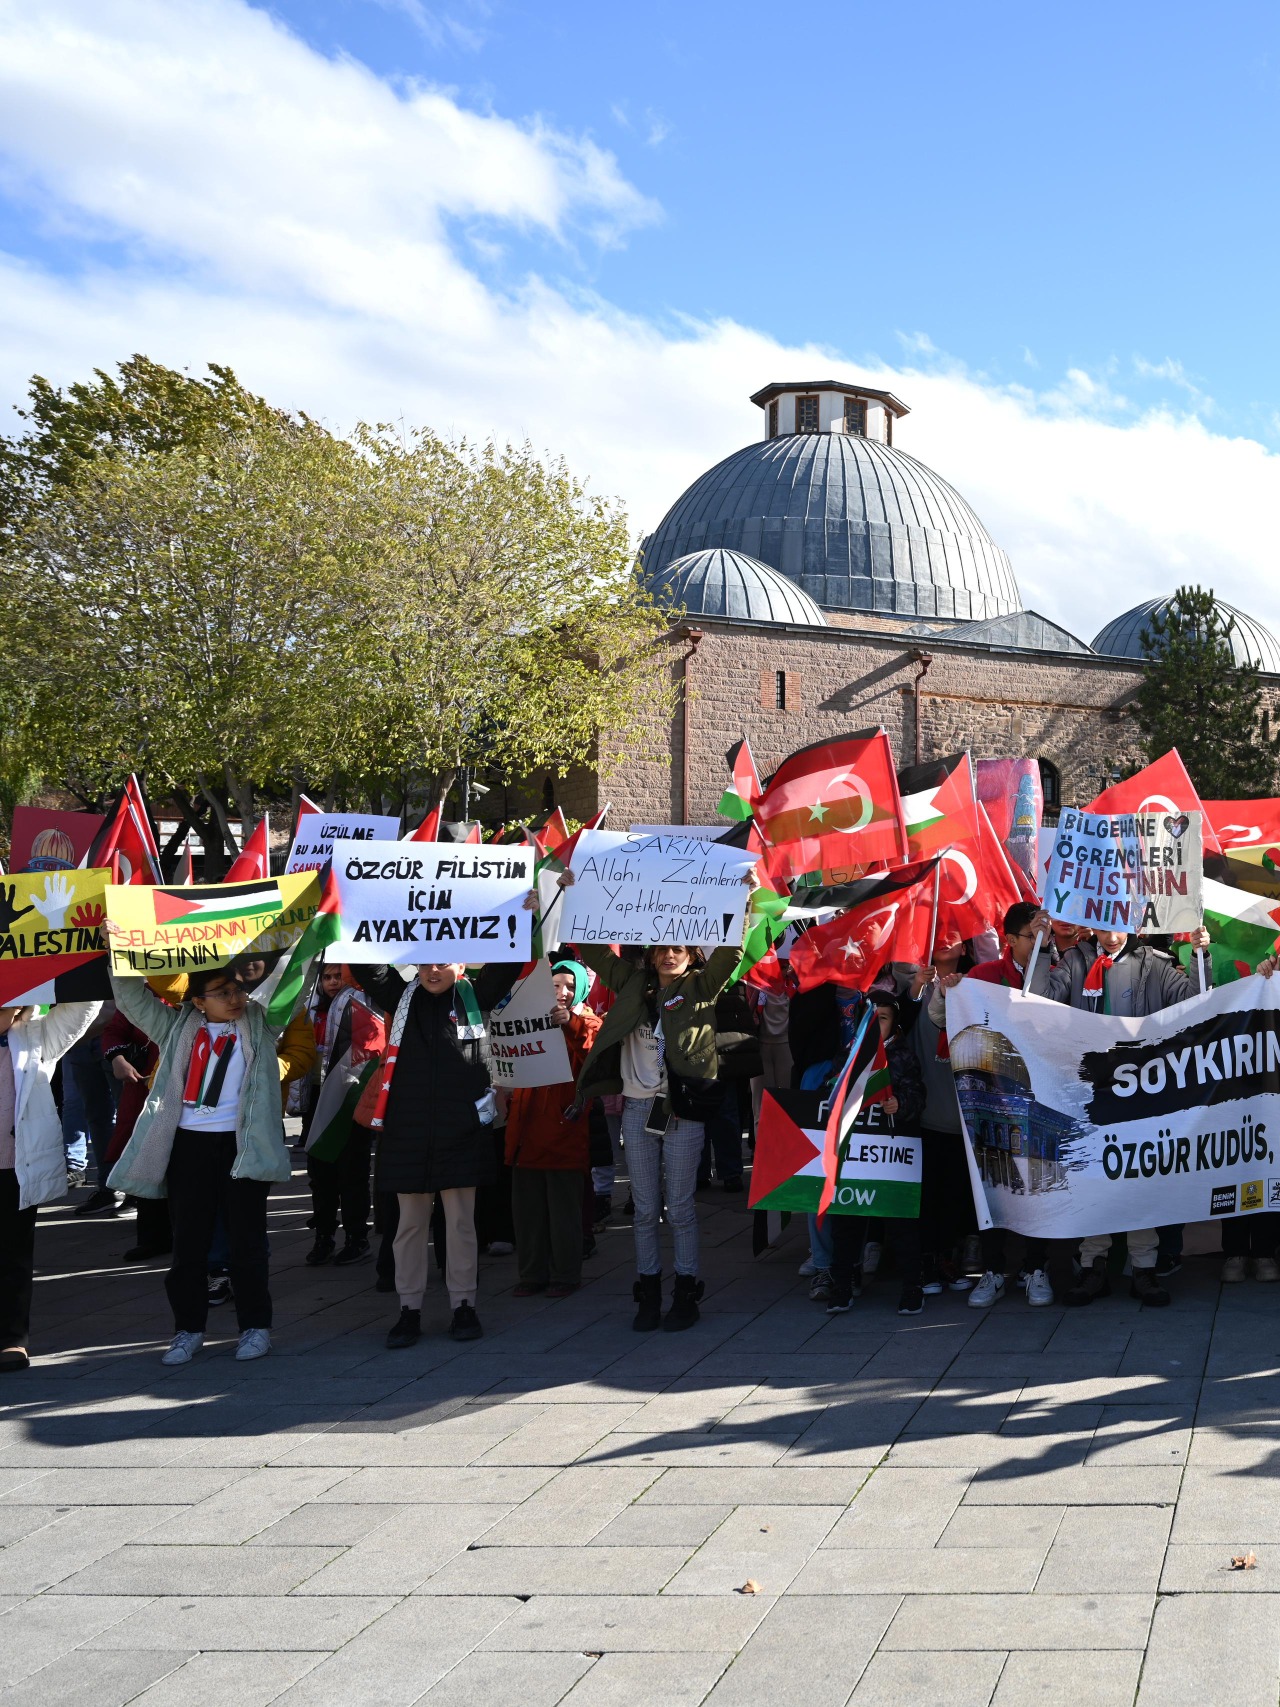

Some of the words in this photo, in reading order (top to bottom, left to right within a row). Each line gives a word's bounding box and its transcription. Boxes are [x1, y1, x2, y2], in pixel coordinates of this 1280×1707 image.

[320, 822, 375, 840] ÜZÜLME
[1065, 812, 1156, 839] BİLGEHANE
[295, 844, 308, 855] BU
[345, 856, 424, 880] ÖZGÜR
[435, 855, 527, 880] FİLİSTİN
[1059, 860, 1188, 897] FİLİSTİNİN
[407, 885, 453, 912] İÇİN
[352, 915, 500, 943] AYAKTAYIZ
[507, 914, 517, 949] !
[570, 914, 643, 941] Habersiz
[1102, 1123, 1191, 1182] ÖZGÜR
[1196, 1114, 1274, 1172] KUDÜS,
